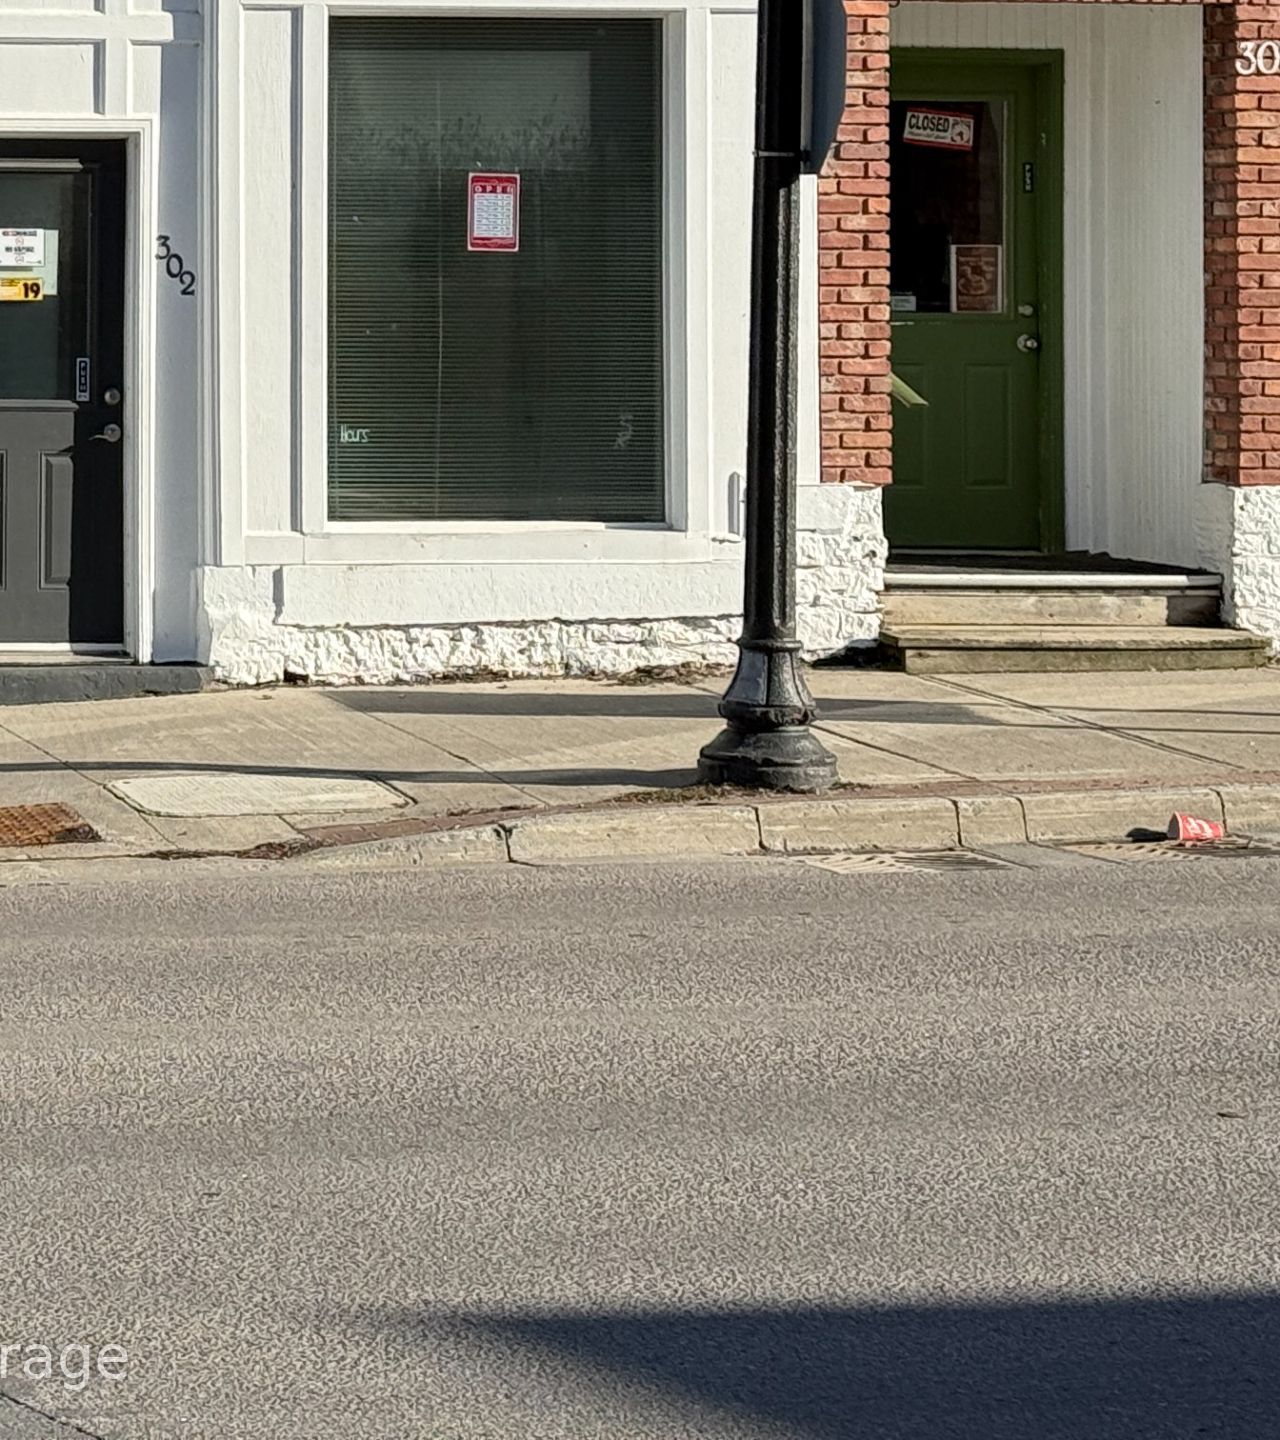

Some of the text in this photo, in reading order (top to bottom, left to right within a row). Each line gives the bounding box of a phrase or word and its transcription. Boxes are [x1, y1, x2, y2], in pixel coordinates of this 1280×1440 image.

[908, 113, 951, 133] CLOSED
[155, 235, 196, 296] 302
[22, 281, 41, 299] 19
